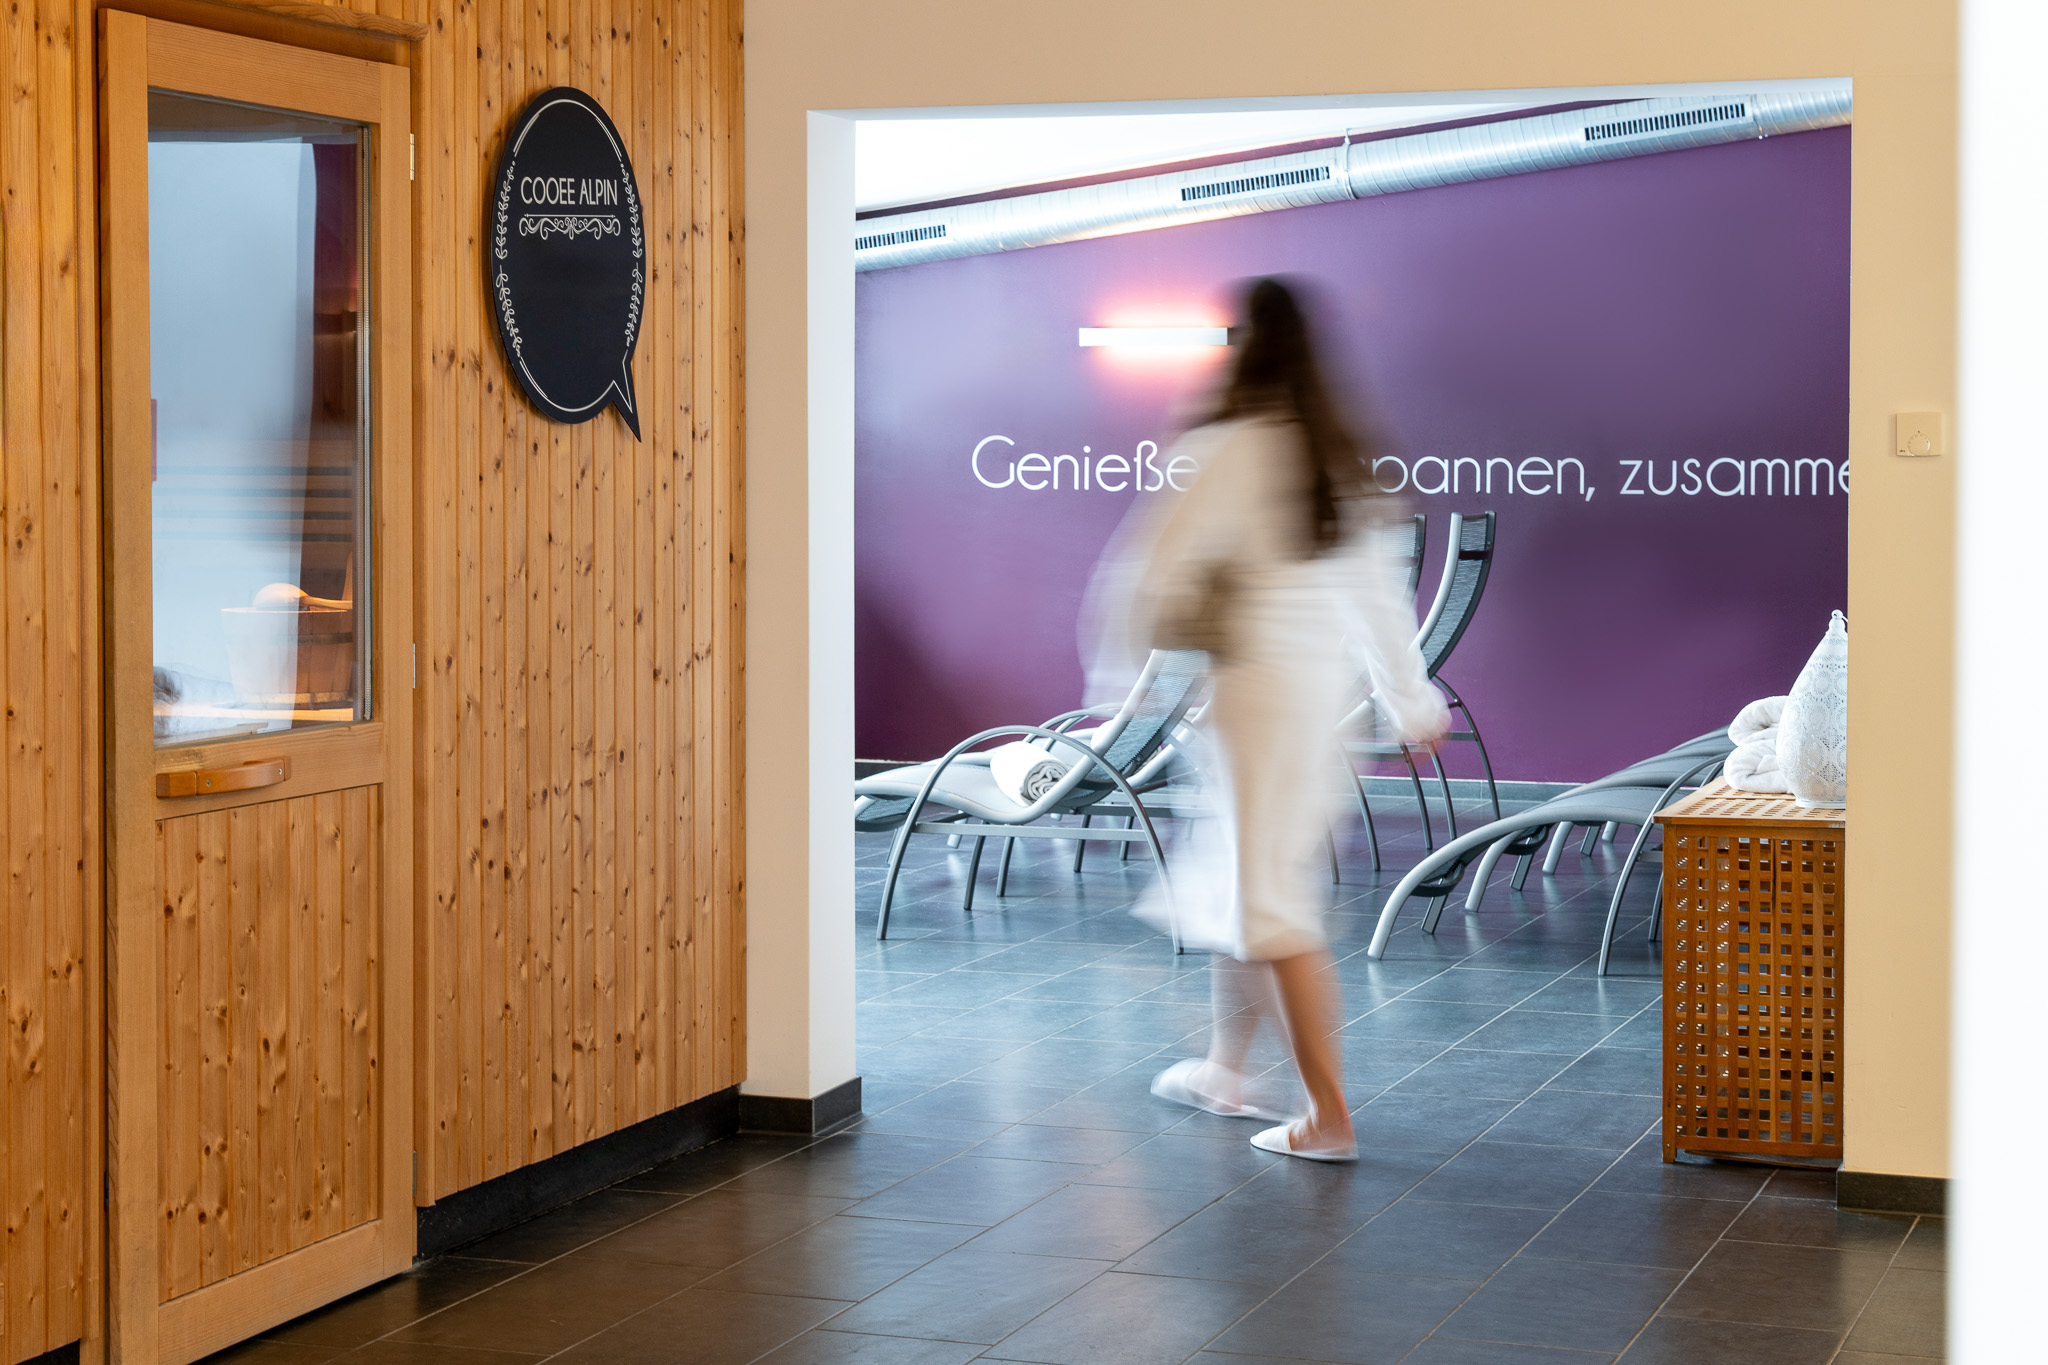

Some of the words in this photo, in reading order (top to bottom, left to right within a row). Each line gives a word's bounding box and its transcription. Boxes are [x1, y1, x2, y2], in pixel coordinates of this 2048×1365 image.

[520, 176, 576, 205] COOEE
[579, 178, 618, 206] ALPIN
[1358, 455, 1596, 502] pannen,
